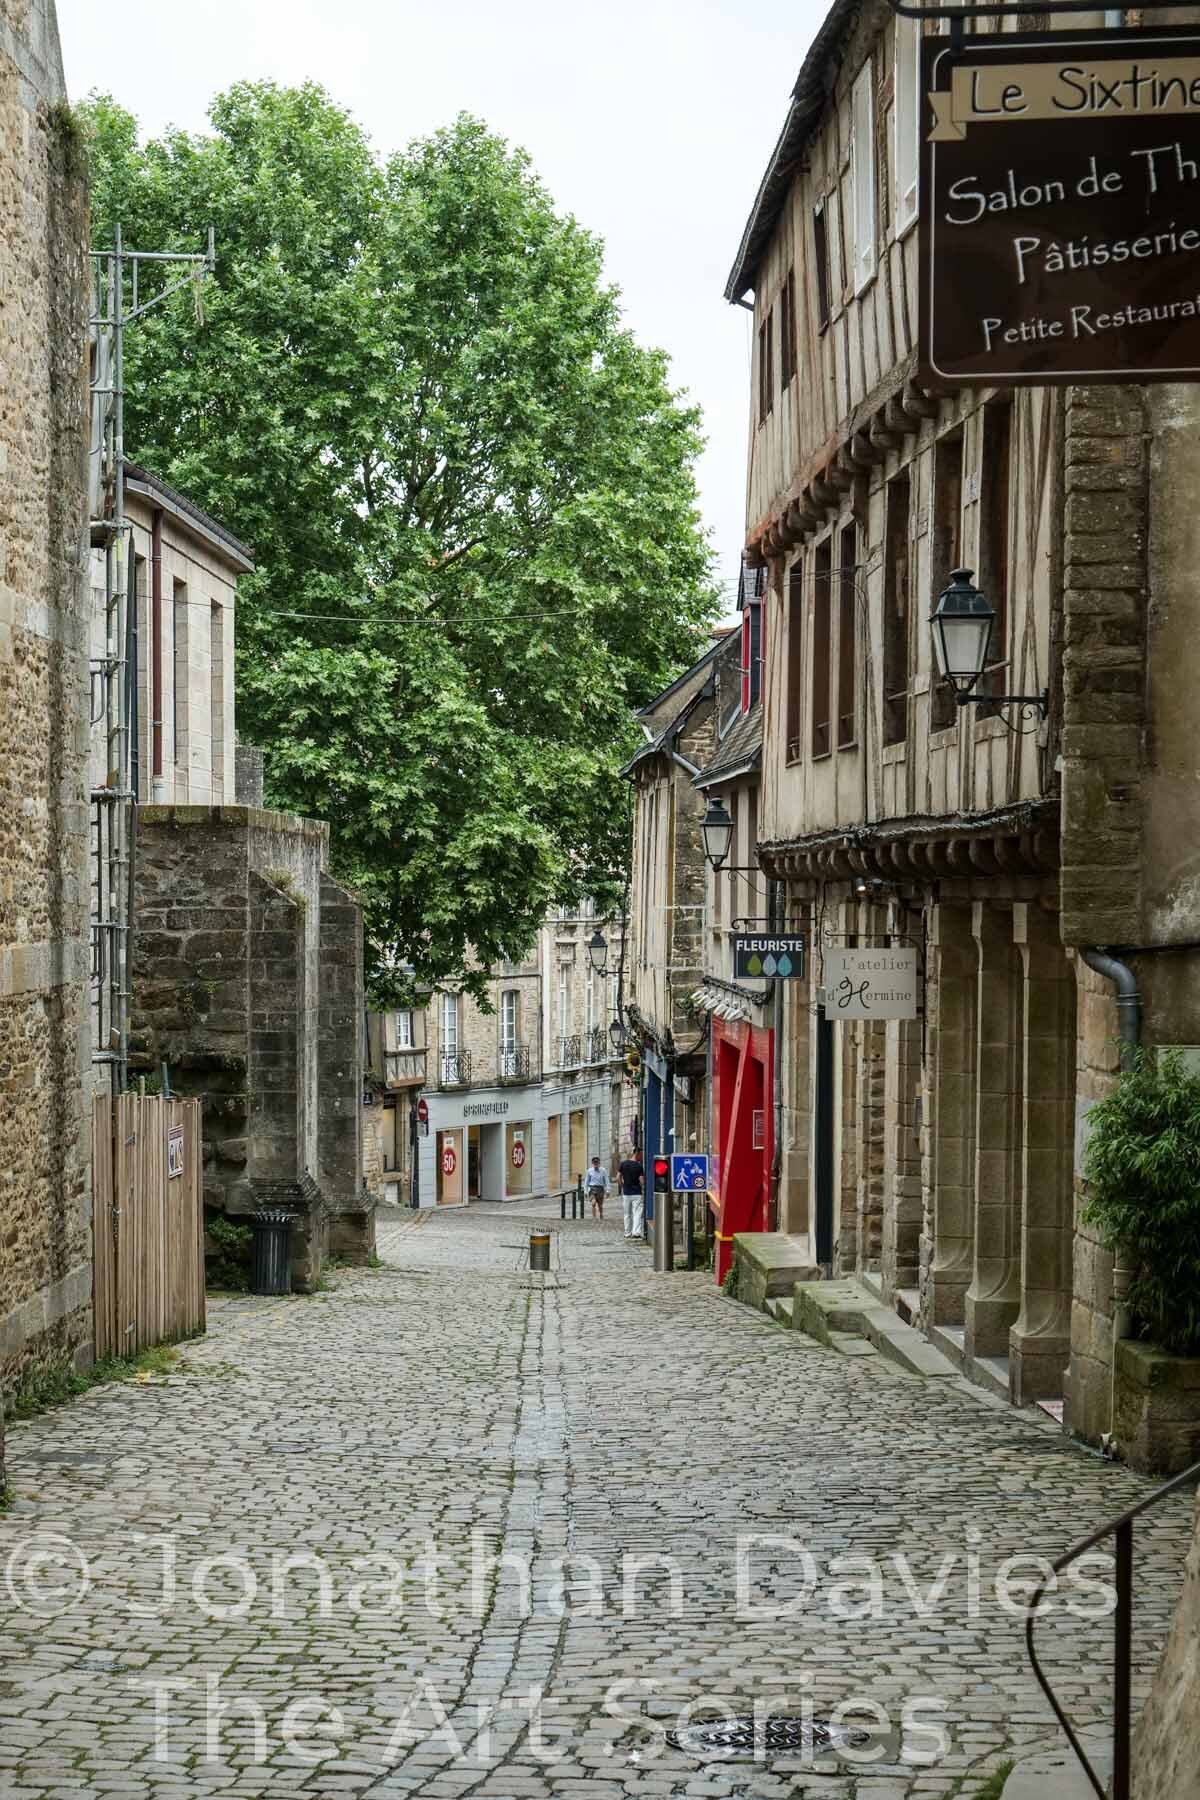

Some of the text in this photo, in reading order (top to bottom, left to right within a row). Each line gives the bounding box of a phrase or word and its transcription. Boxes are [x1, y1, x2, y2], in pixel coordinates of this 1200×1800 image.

[972, 71, 1027, 114] Le
[945, 169, 1065, 224] Salon
[1077, 156, 1123, 197] de
[1013, 221, 1200, 284] Pâtisserie
[982, 317, 1064, 351] Petite
[736, 940, 803, 952] FLEURISTE
